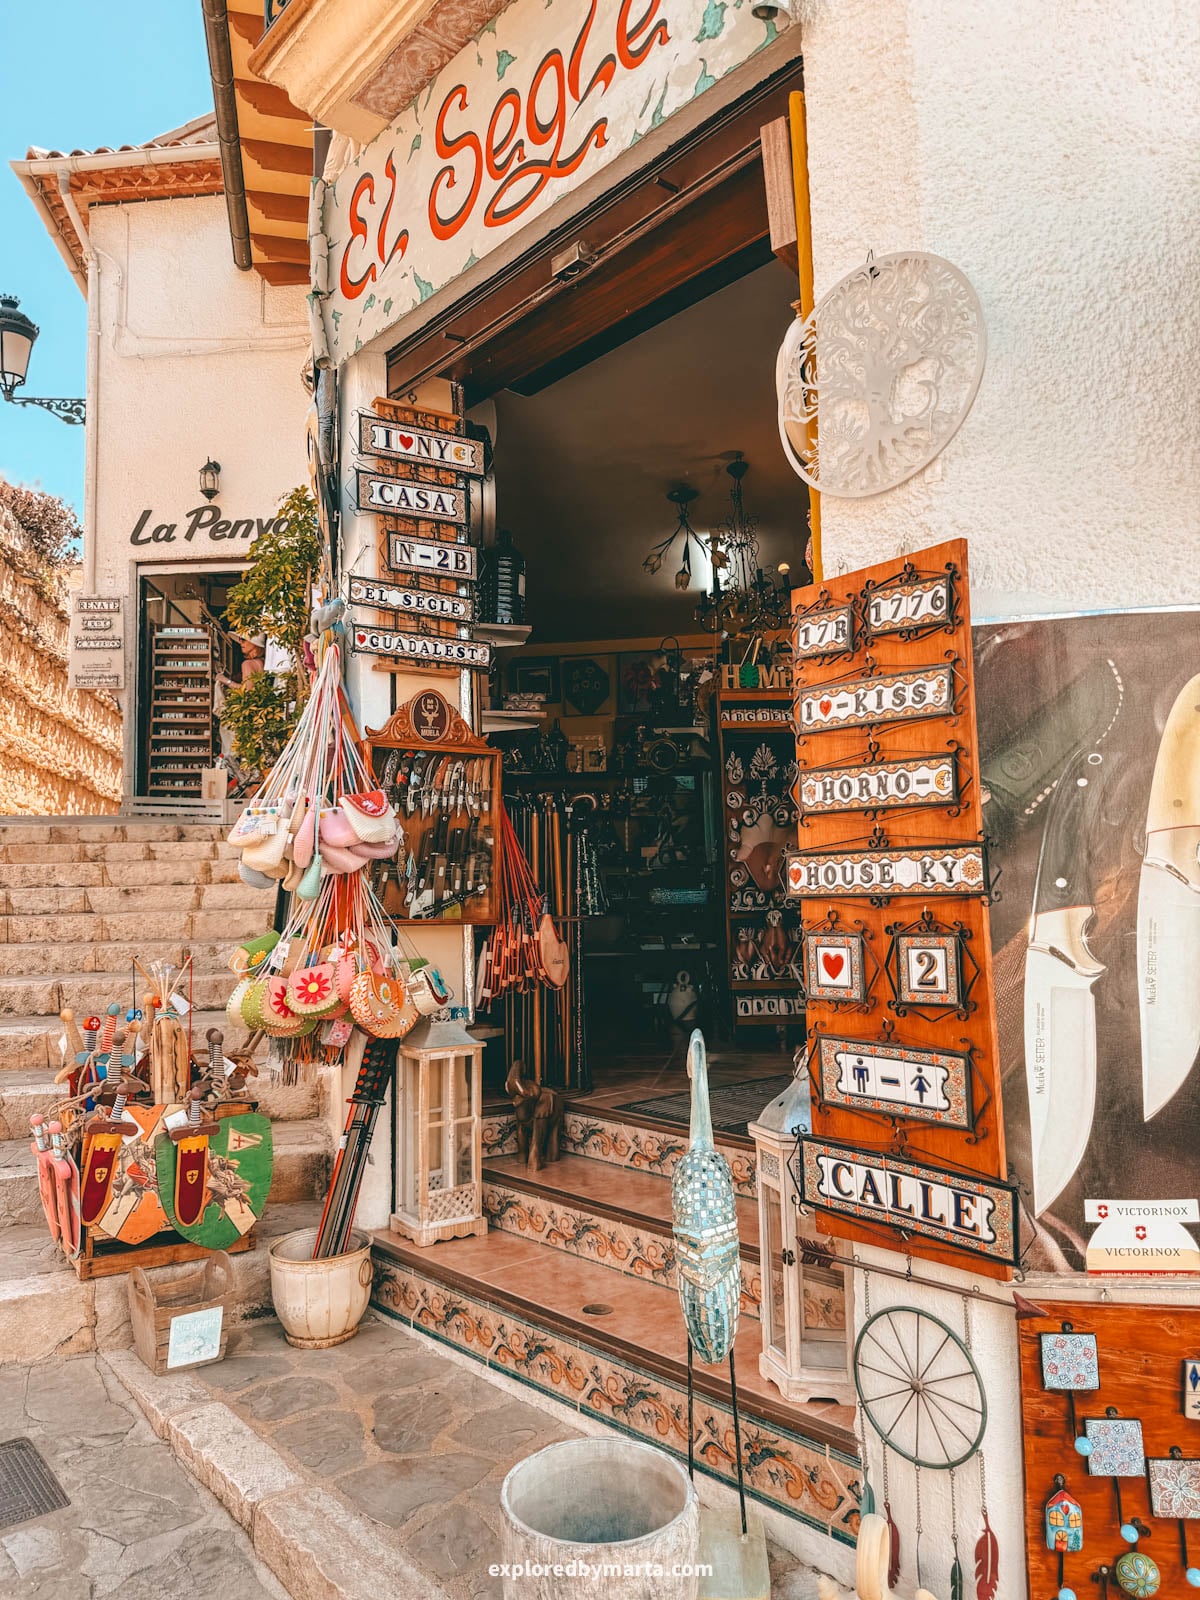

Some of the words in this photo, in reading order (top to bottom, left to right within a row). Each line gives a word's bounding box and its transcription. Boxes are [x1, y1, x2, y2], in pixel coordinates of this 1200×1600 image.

[340, 148, 410, 300] El
[384, 428, 394, 450] I
[416, 436, 450, 460] NY
[378, 484, 449, 514] CASA
[130, 509, 177, 546] La
[365, 587, 388, 603] EL
[402, 593, 461, 615] SEGLE
[871, 588, 945, 623] 1776
[801, 619, 848, 646] 17R
[369, 635, 478, 660] GUADALEST
[804, 701, 814, 722] I
[420, 729, 440, 737] MUELA
[806, 862, 895, 886] HOUSE
[918, 860, 958, 884] KY
[916, 950, 938, 989] 2
[1146, 950, 1157, 976] SETTER
[1035, 1037, 1046, 1064] SETTER
[831, 1162, 981, 1237] CALLE
[1116, 1206, 1189, 1216] VICTORINOX
[1104, 1247, 1181, 1257] VICTORINOX
